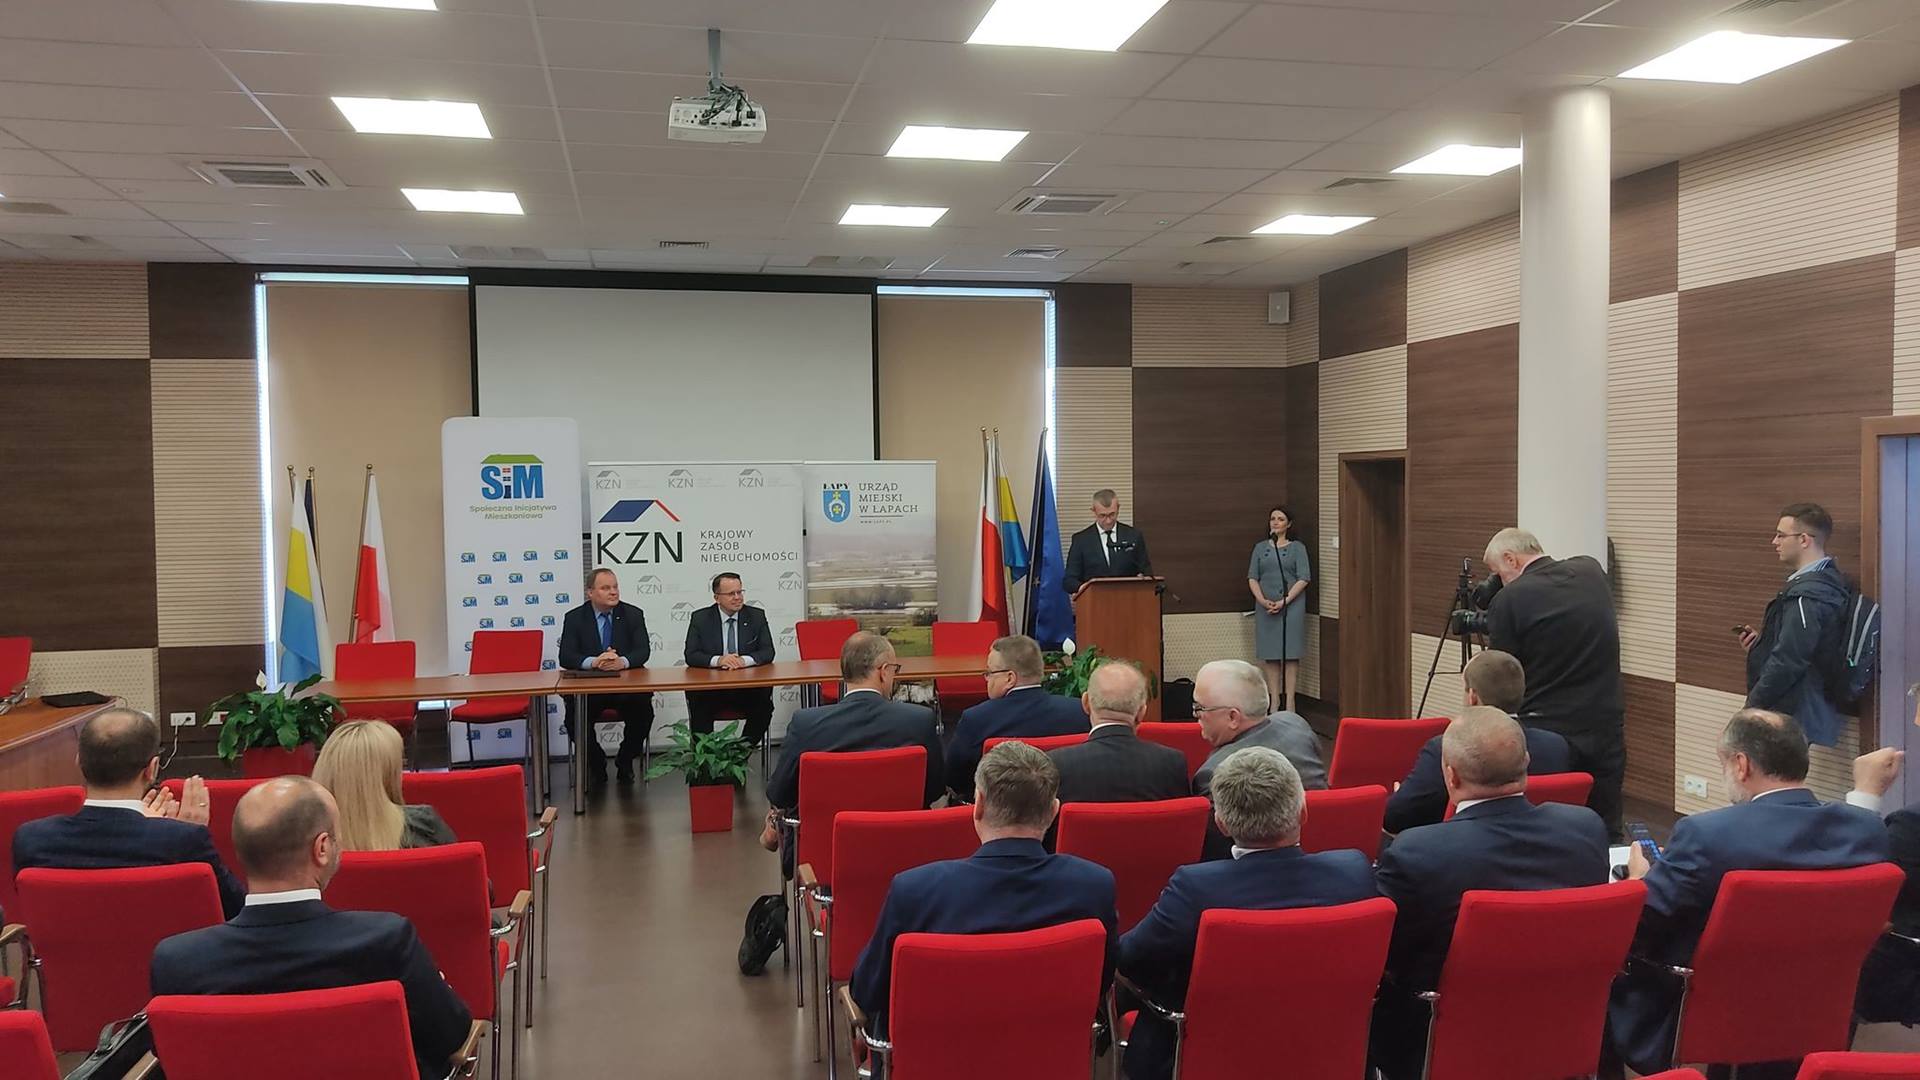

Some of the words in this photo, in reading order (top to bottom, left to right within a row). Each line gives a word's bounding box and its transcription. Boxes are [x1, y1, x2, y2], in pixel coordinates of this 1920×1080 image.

[596, 479, 622, 489] KZN
[668, 478, 694, 488] KZN
[738, 477, 764, 487] KZN
[859, 483, 898, 492] URZĄD
[859, 494, 902, 502] MIEJSKI
[515, 504, 557, 512] Inicjatywa
[859, 505, 869, 513] W
[873, 505, 918, 513] ŁAPACH
[700, 530, 753, 539] KRAJOWY
[597, 532, 683, 564] KZN
[700, 541, 740, 550] ZASÓB
[701, 551, 798, 562] NIERUCHOMOŚCI
[637, 584, 662, 594] KZN
[778, 580, 802, 591] KZN
